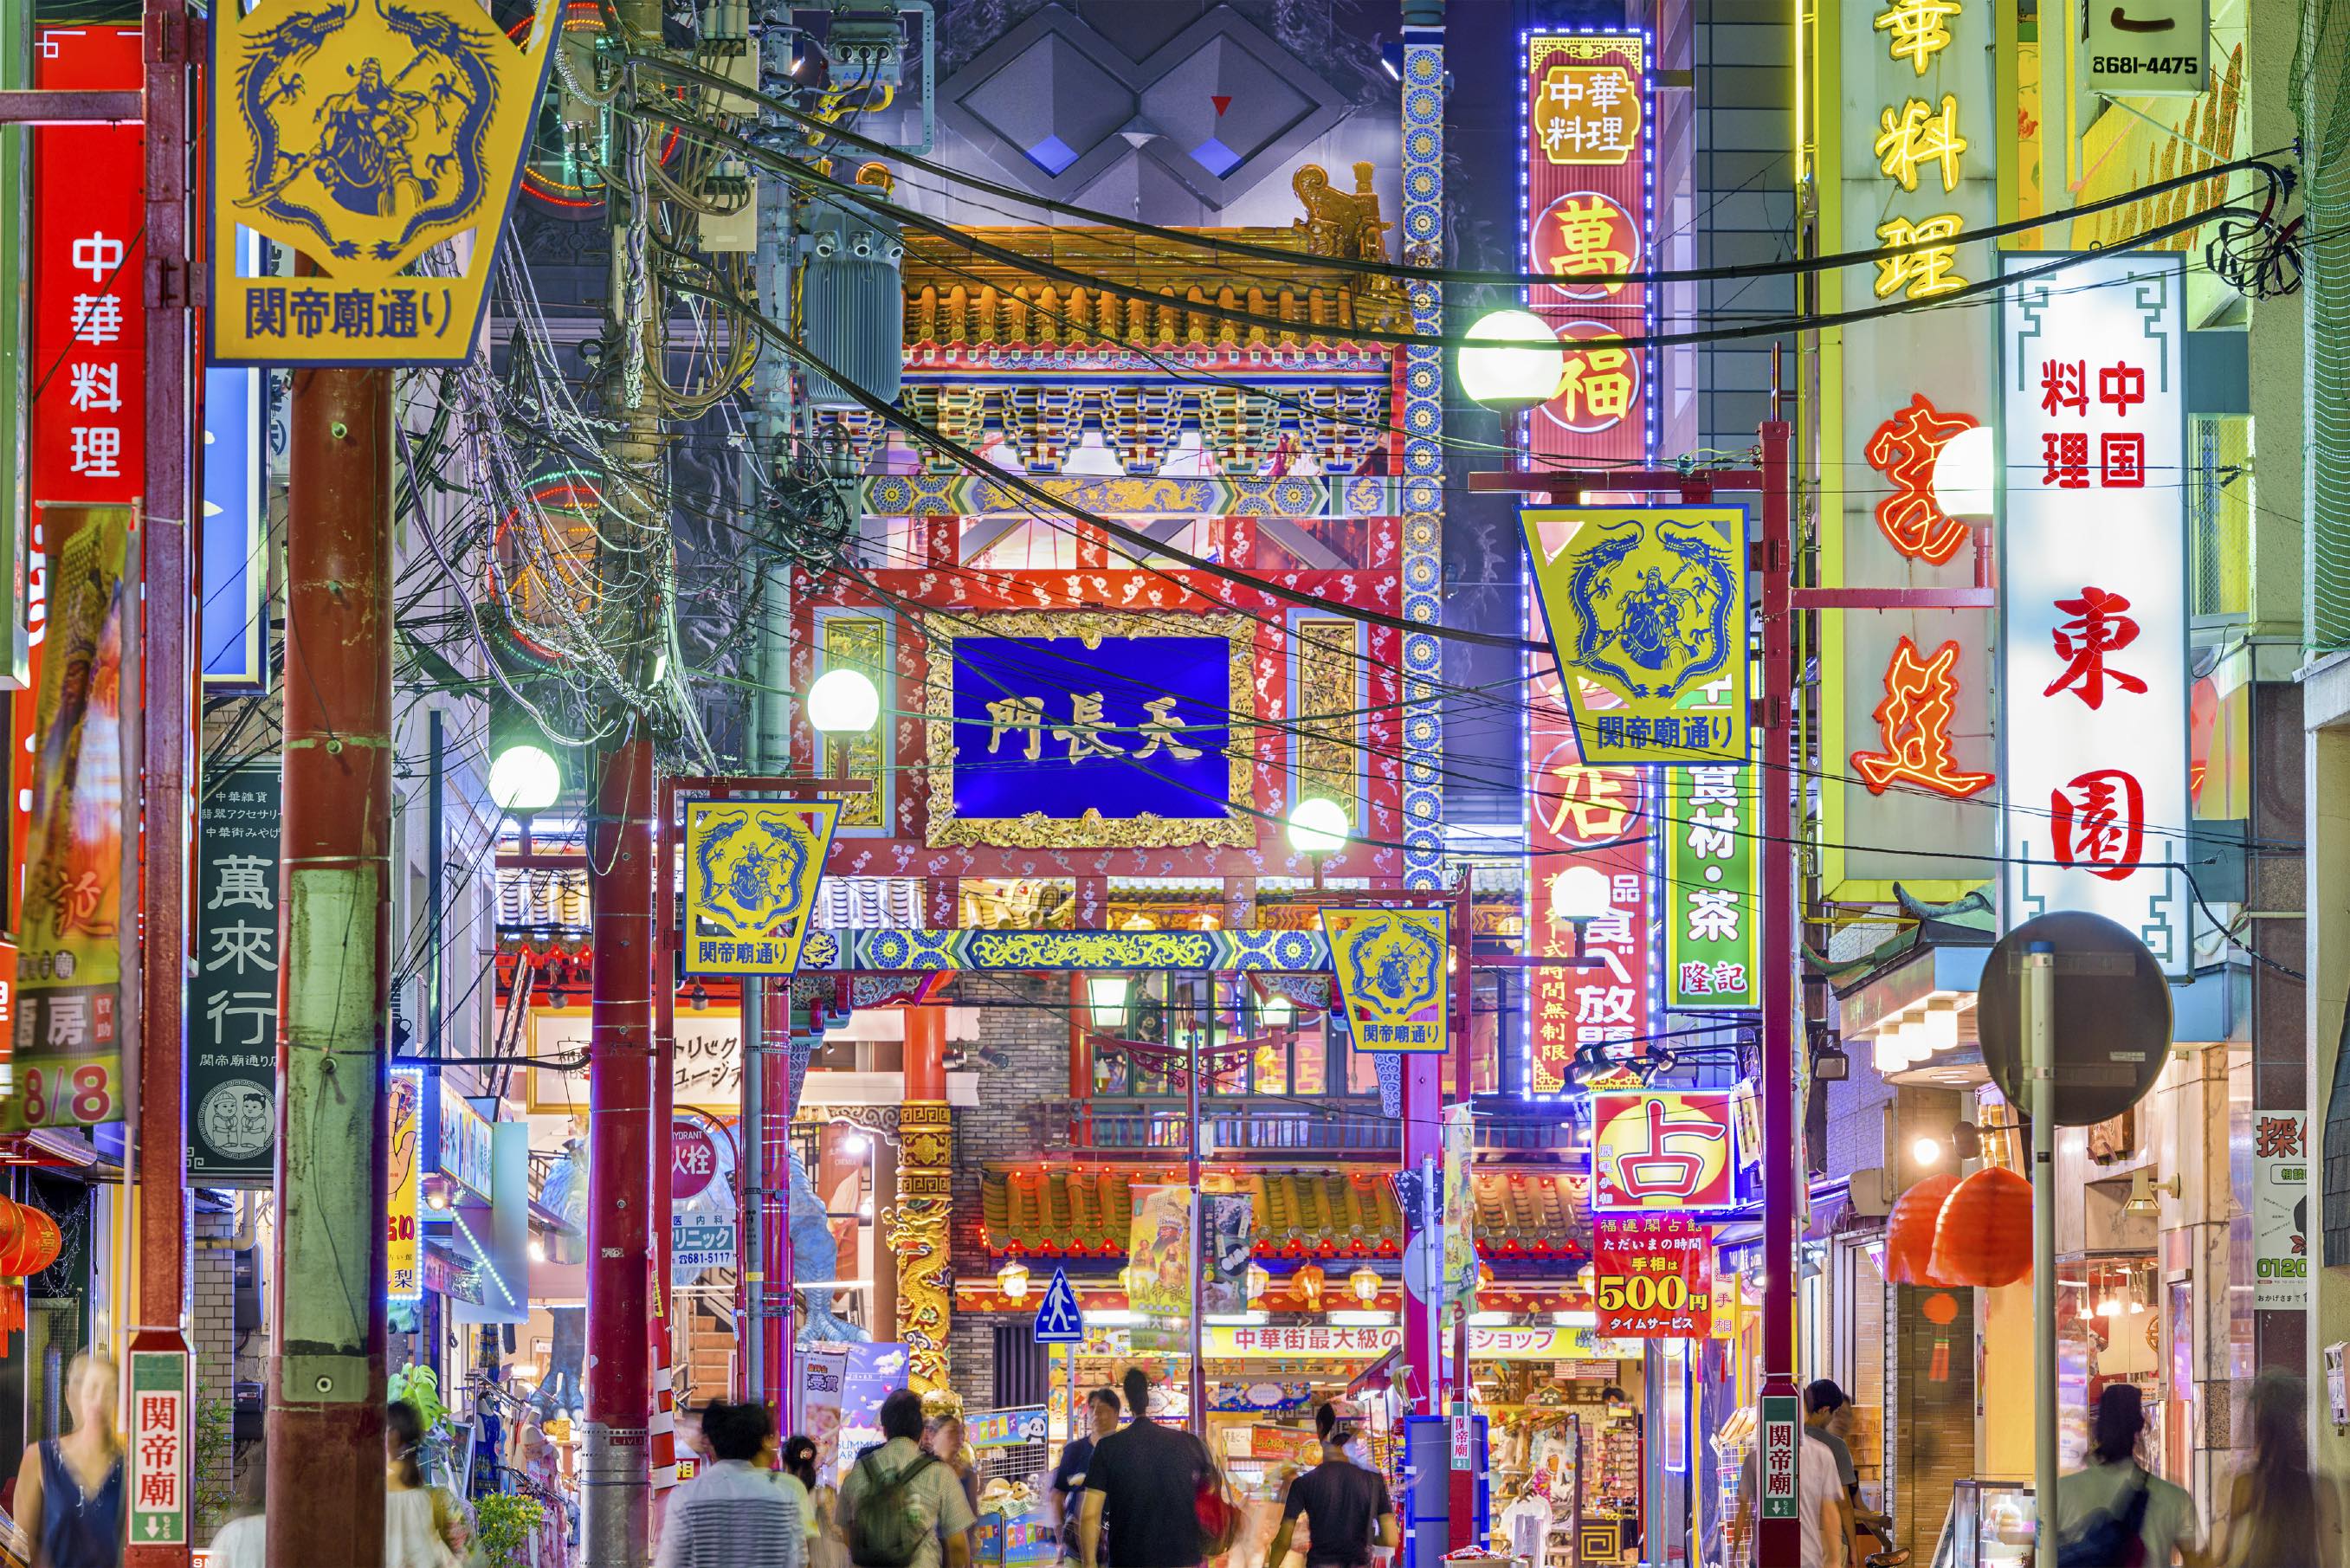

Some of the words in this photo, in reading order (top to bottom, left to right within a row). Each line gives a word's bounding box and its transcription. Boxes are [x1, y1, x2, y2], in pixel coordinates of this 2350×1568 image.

[2107, 56, 2198, 74] 681-4475
[245, 287, 451, 339] 関帝廟通り
[70, 231, 124, 478] 中華料理
[1598, 715, 1732, 750] 関帝廟通り
[2043, 585, 2148, 881] 東園
[216, 791, 268, 803] 中華雑貨
[205, 854, 279, 1045] 萬來行
[699, 941, 787, 964] 関帝廟通り
[1680, 961, 1746, 996] 隆記
[1363, 1023, 1439, 1044] 関帝廟通り
[24, 1064, 111, 1125] 8/8
[1617, 1100, 1727, 1198] 占
[2281, 1168, 2308, 1181] 相談
[688, 1253, 731, 1265] 681-5117
[1603, 1238, 1702, 1252] ただいまの時間
[1631, 1257, 1678, 1272] 手相は
[1598, 1274, 1708, 1313] 500円
[1610, 1317, 1695, 1331] タイムサービス
[139, 1397, 178, 1508] 関帝廟
[1767, 1424, 1792, 1495] 関帝廟
